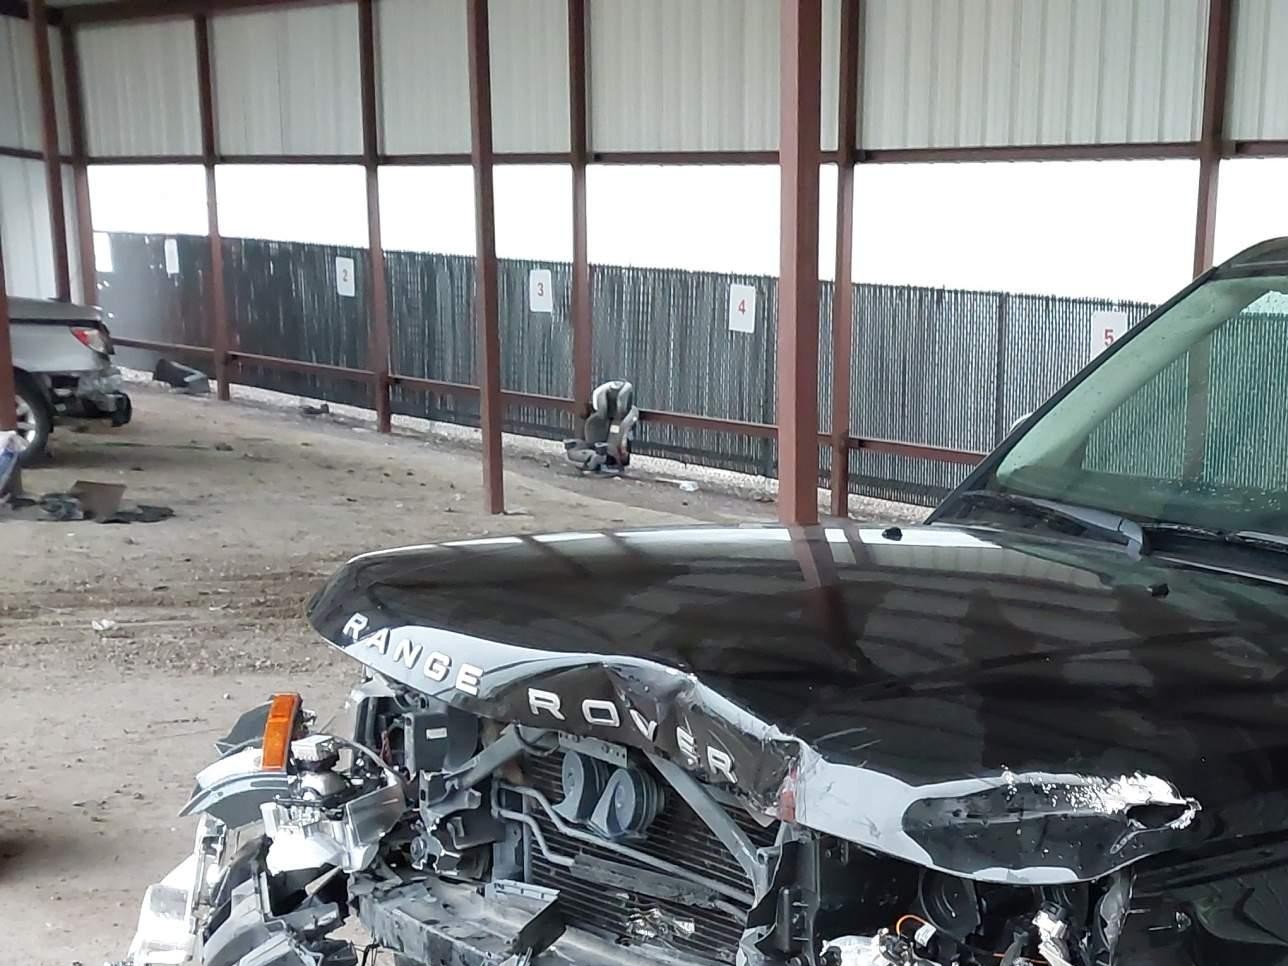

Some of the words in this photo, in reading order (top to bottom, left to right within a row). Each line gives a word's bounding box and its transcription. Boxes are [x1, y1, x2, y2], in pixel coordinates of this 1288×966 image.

[342, 268, 349, 282] 2
[537, 282, 544, 297] 3
[738, 299, 746, 316] 4
[1104, 328, 1115, 347] 5
[342, 611, 485, 696] RANGE
[527, 687, 739, 784] ROVER
